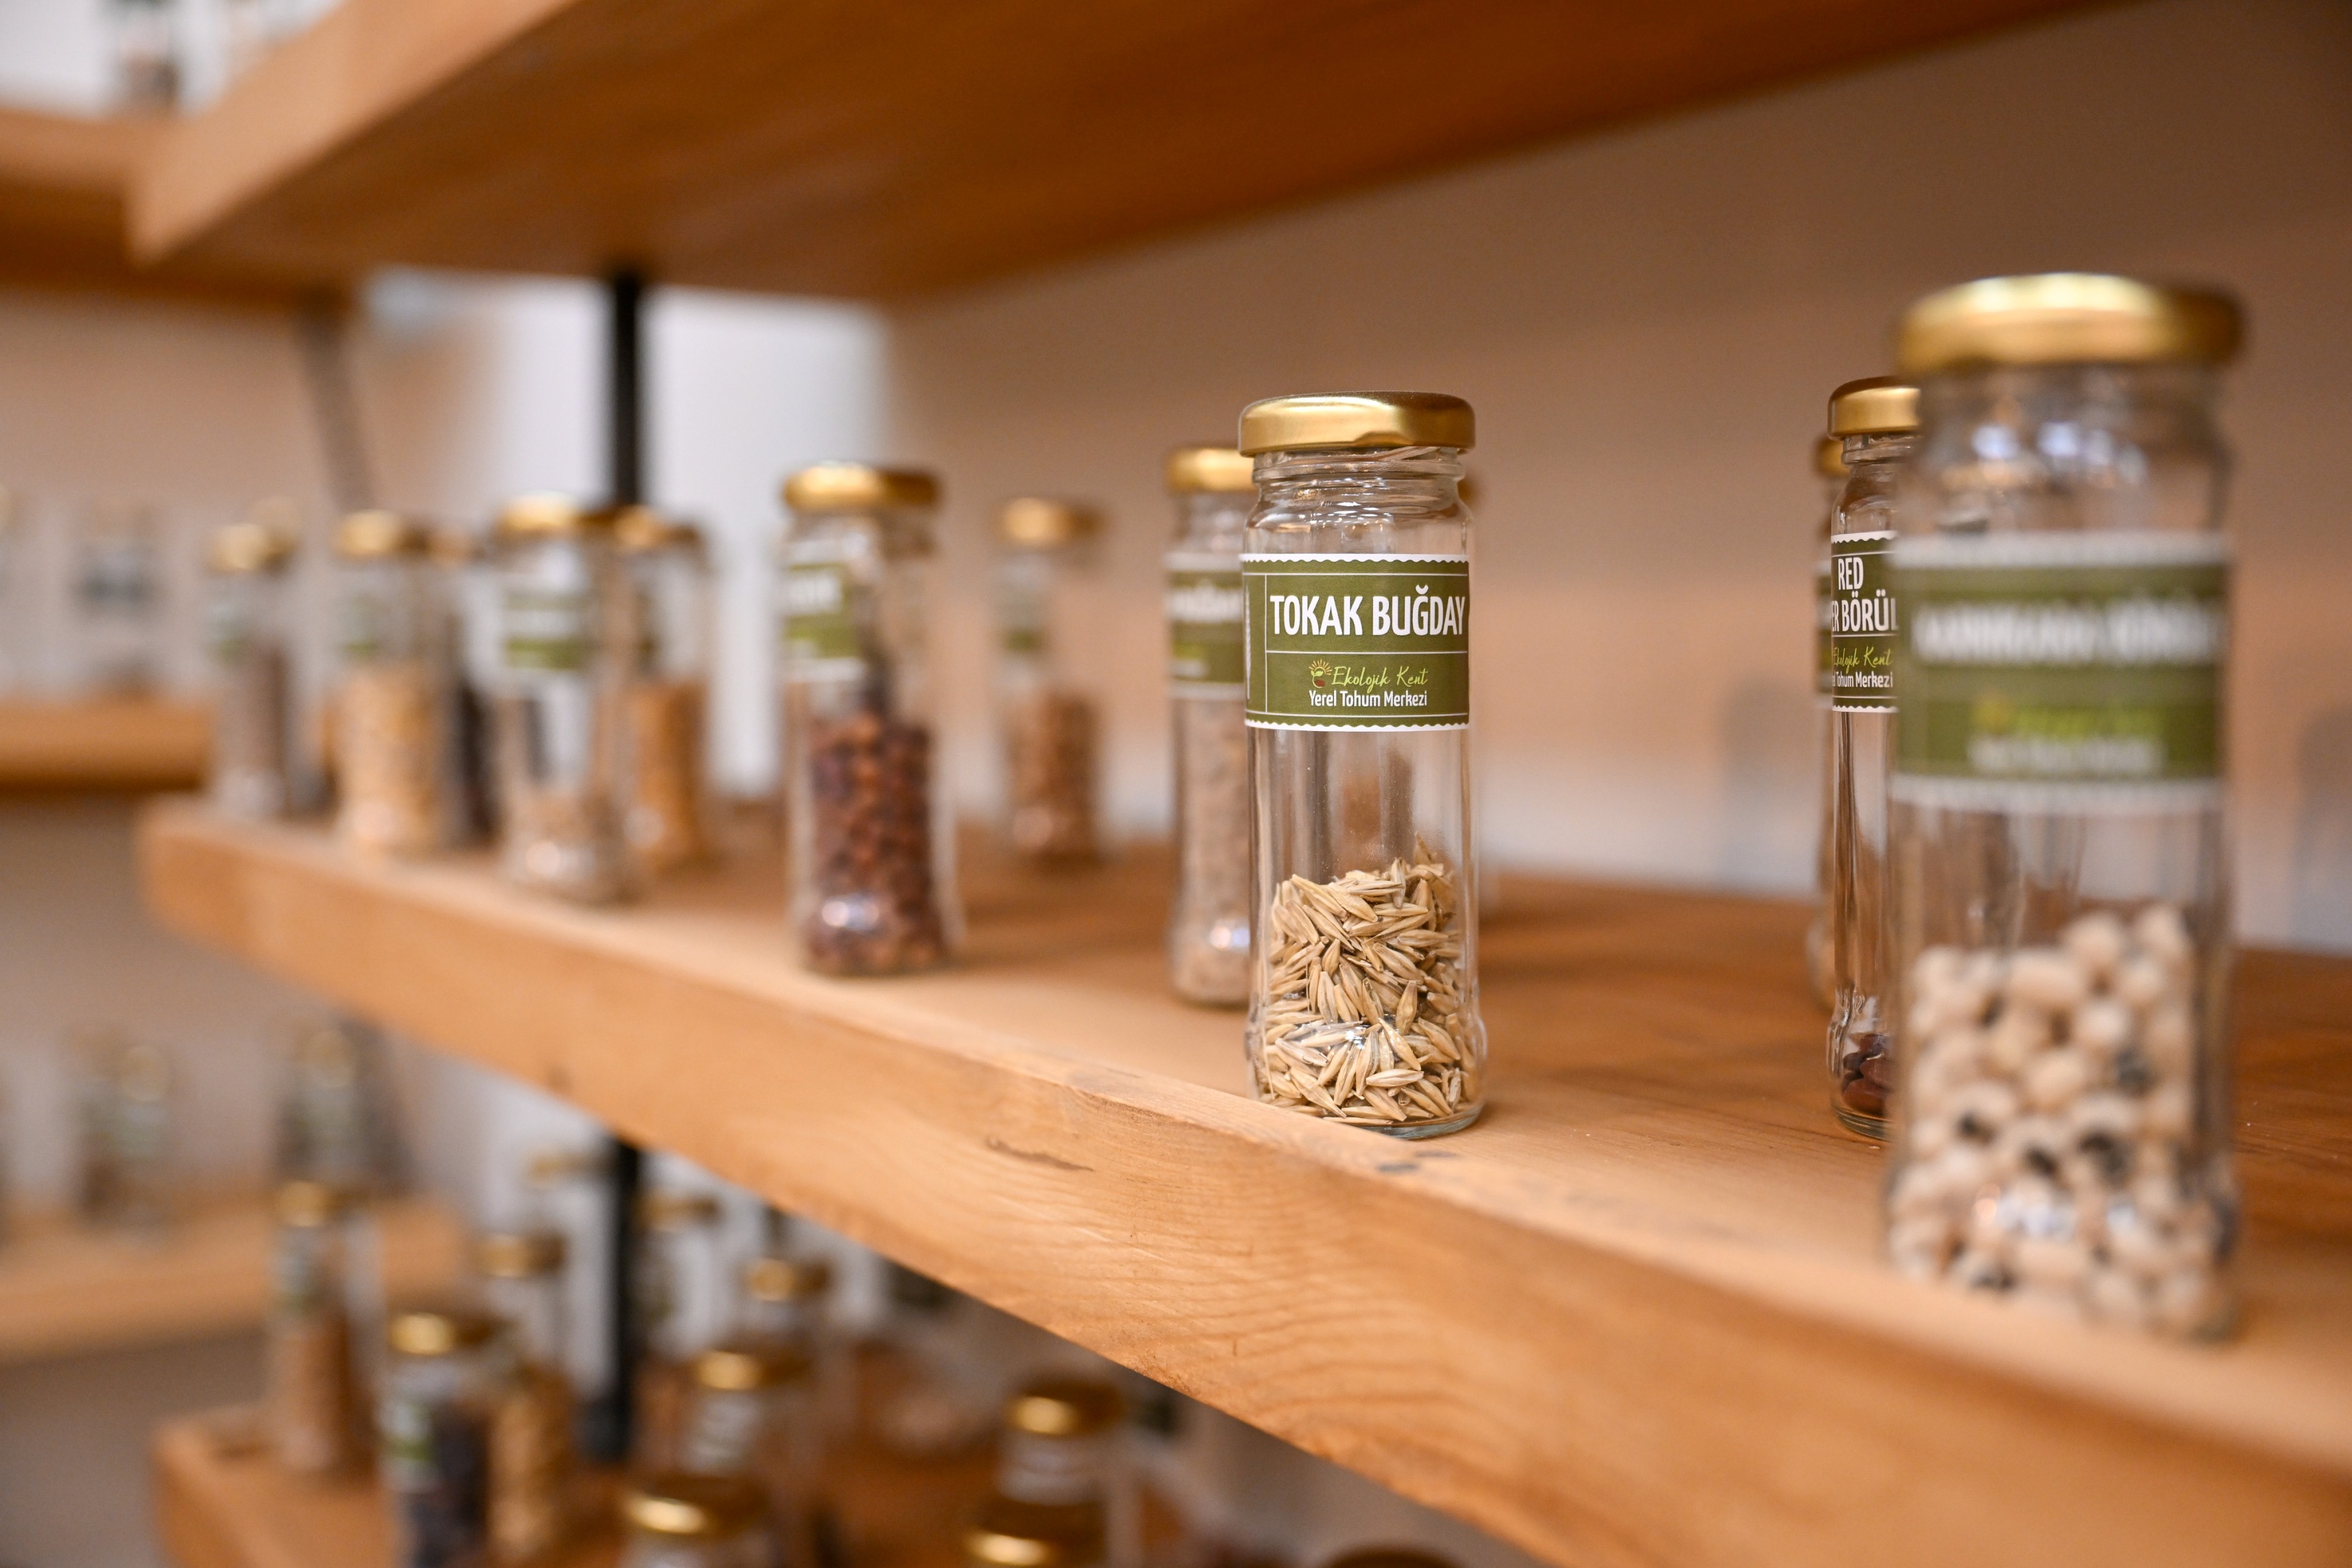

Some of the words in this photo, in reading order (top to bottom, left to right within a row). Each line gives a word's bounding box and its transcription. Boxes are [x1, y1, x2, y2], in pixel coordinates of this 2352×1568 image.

[1837, 557, 1864, 590] RED
[1269, 595, 1363, 636] TOKAK
[1372, 584, 1466, 636] BUĞDAY
[1841, 588, 1899, 632] BÖRÜL
[1863, 645, 1892, 668] Kent
[1331, 666, 1391, 694] Ekolojik
[1396, 666, 1429, 687] Kent
[1835, 671, 1854, 688] Tohum
[1855, 670, 1893, 688] Merkezi
[1308, 690, 1337, 707] Yerel
[1340, 690, 1381, 707] Tohum
[1383, 690, 1427, 707] Merkezi
